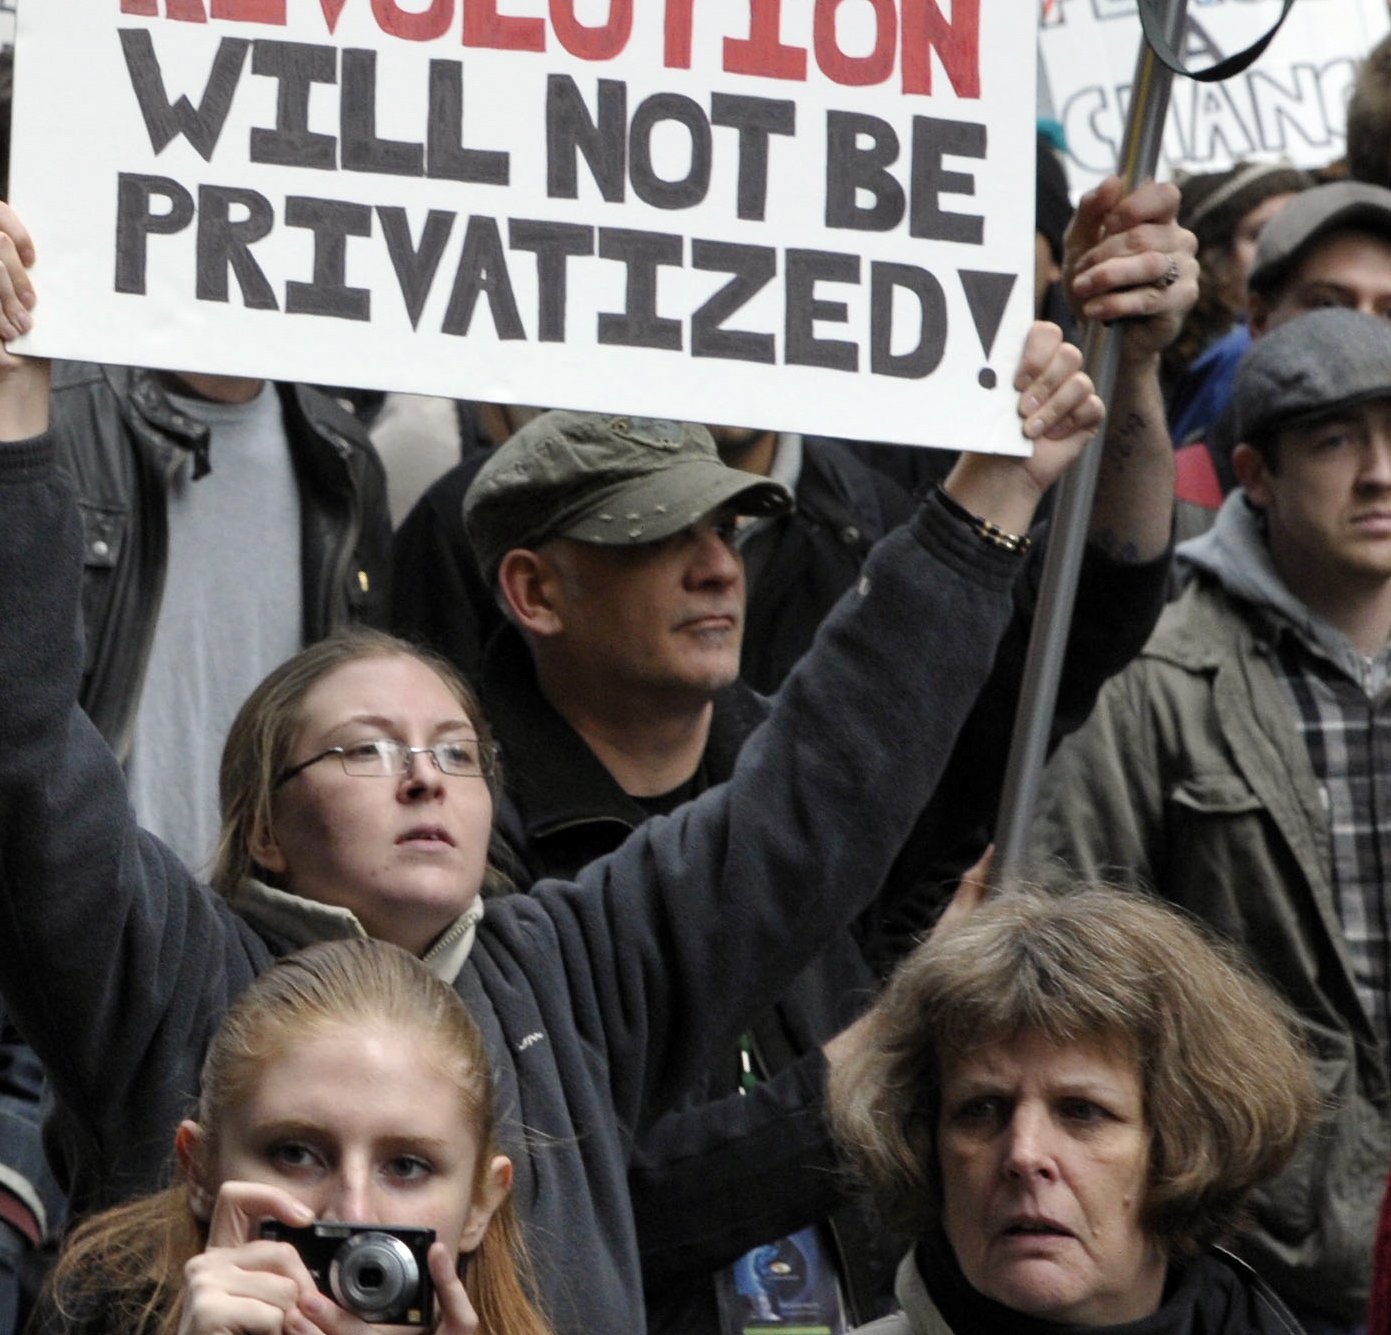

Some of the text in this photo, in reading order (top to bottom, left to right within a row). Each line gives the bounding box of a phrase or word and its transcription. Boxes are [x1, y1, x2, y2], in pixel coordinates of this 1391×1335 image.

[117, 27, 988, 245] WILL NOT BE
[113, 172, 1018, 391] PRIVATIZED!
